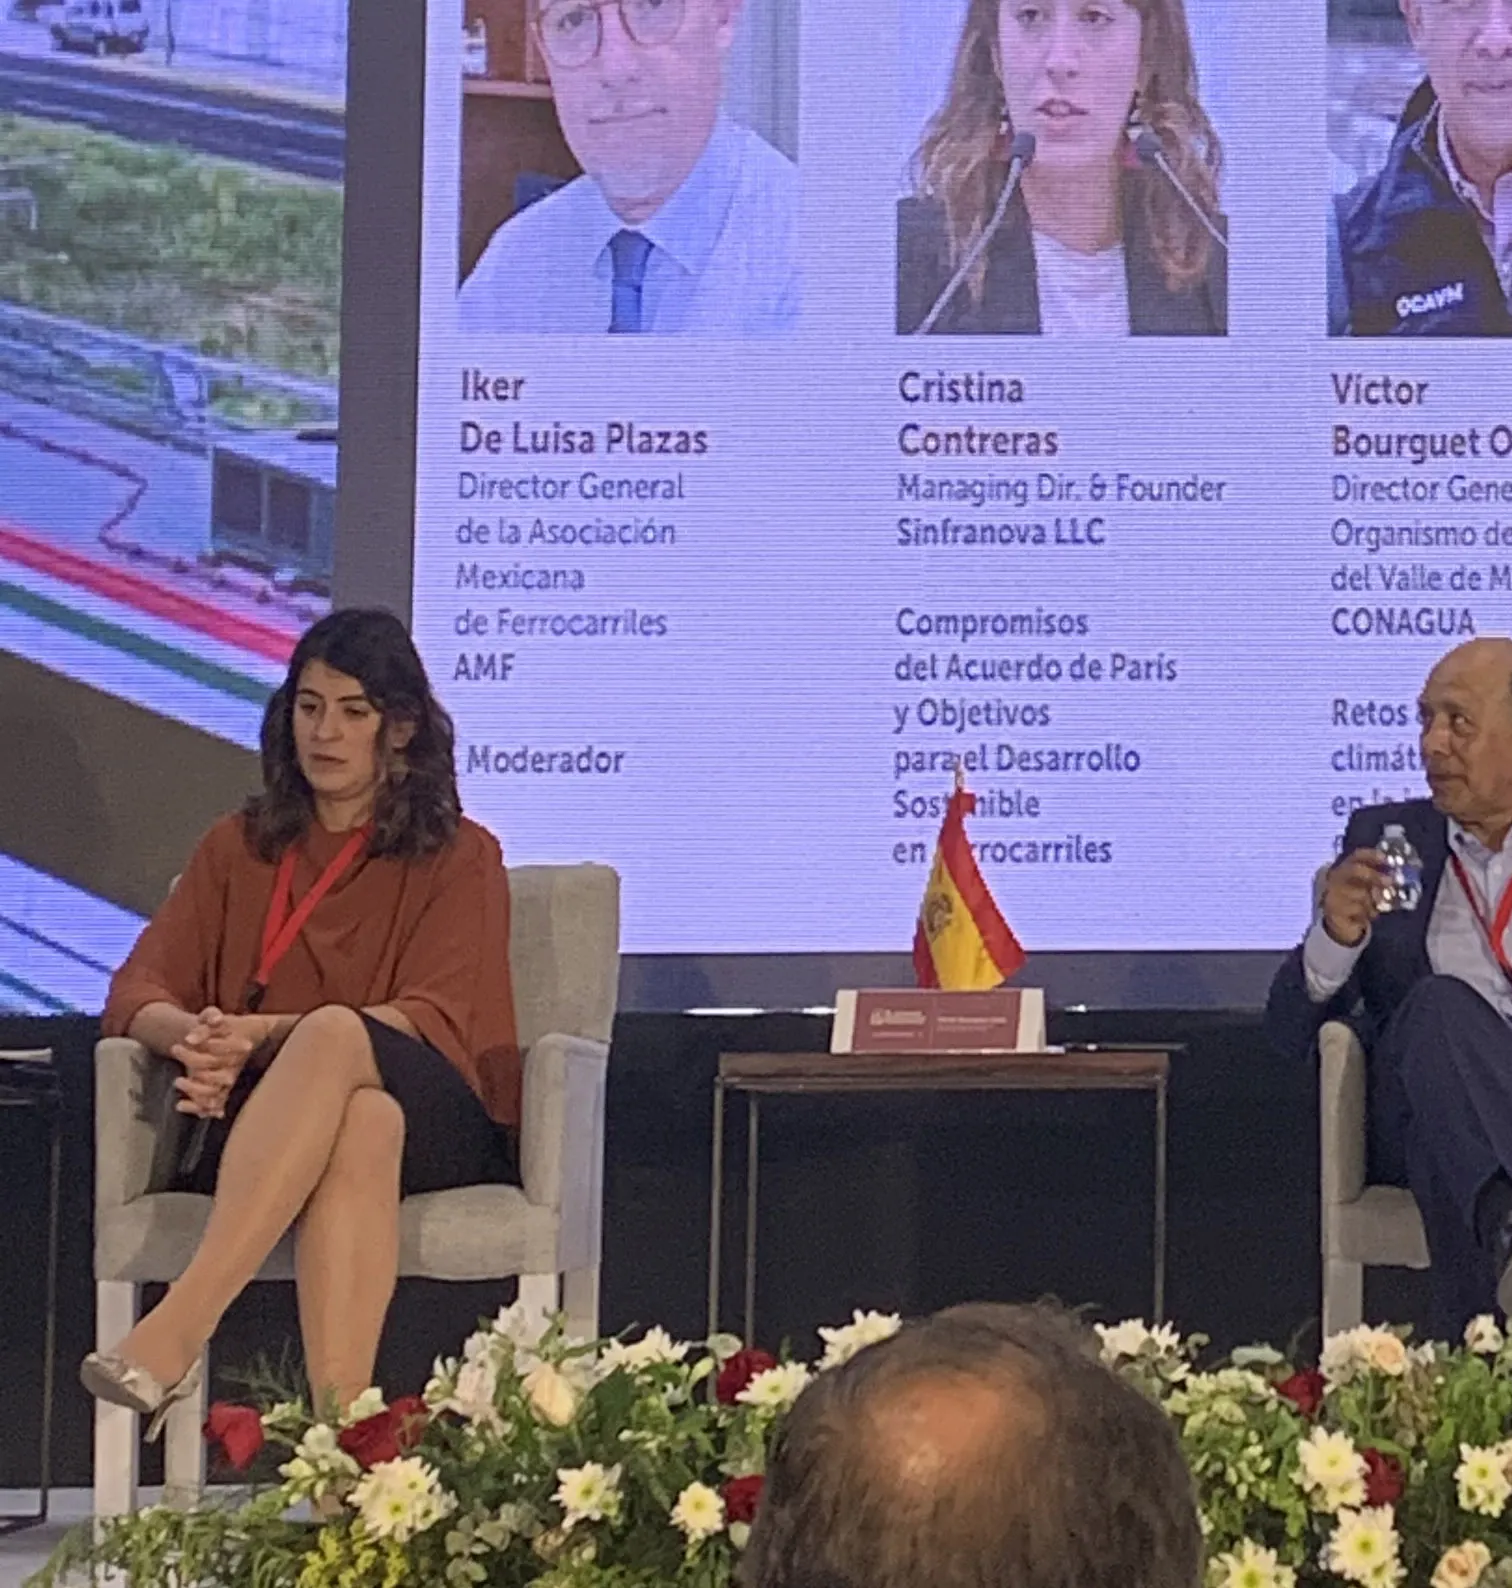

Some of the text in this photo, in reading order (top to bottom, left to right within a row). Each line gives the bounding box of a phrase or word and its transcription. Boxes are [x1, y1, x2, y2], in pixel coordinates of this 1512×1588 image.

[461, 369, 525, 401] Iker
[898, 370, 1024, 403] Cristina
[1330, 372, 1430, 405] Víctor
[459, 422, 709, 455] De Luisa Plazas
[898, 423, 1058, 456] Contreras
[1332, 424, 1482, 464] Bourguet
[457, 472, 685, 501] Director General
[897, 473, 1226, 507] Managing Dir. & Founder
[1332, 474, 1440, 502] Director
[456, 517, 676, 546] de la Asociación
[897, 517, 1105, 546] Sinfranova LLC
[1331, 518, 1477, 552] Organismo
[456, 563, 586, 591] Mexicana
[1330, 563, 1371, 592] del
[1379, 563, 1443, 592] Valle
[1450, 563, 1481, 592] de
[454, 608, 668, 637] de Ferrocarriles
[896, 607, 1090, 642] Compromisos
[1332, 607, 1477, 636] CONAGUA
[454, 653, 516, 681] AMF
[894, 654, 937, 682] del
[945, 653, 1063, 682] Acuerdo
[1069, 653, 1103, 682] de
[893, 698, 1051, 734] y Objetivos
[1332, 698, 1408, 727] Retos
[466, 745, 626, 774] Moderador
[894, 743, 1142, 780] para el Desarrollo
[892, 839, 927, 864] en
